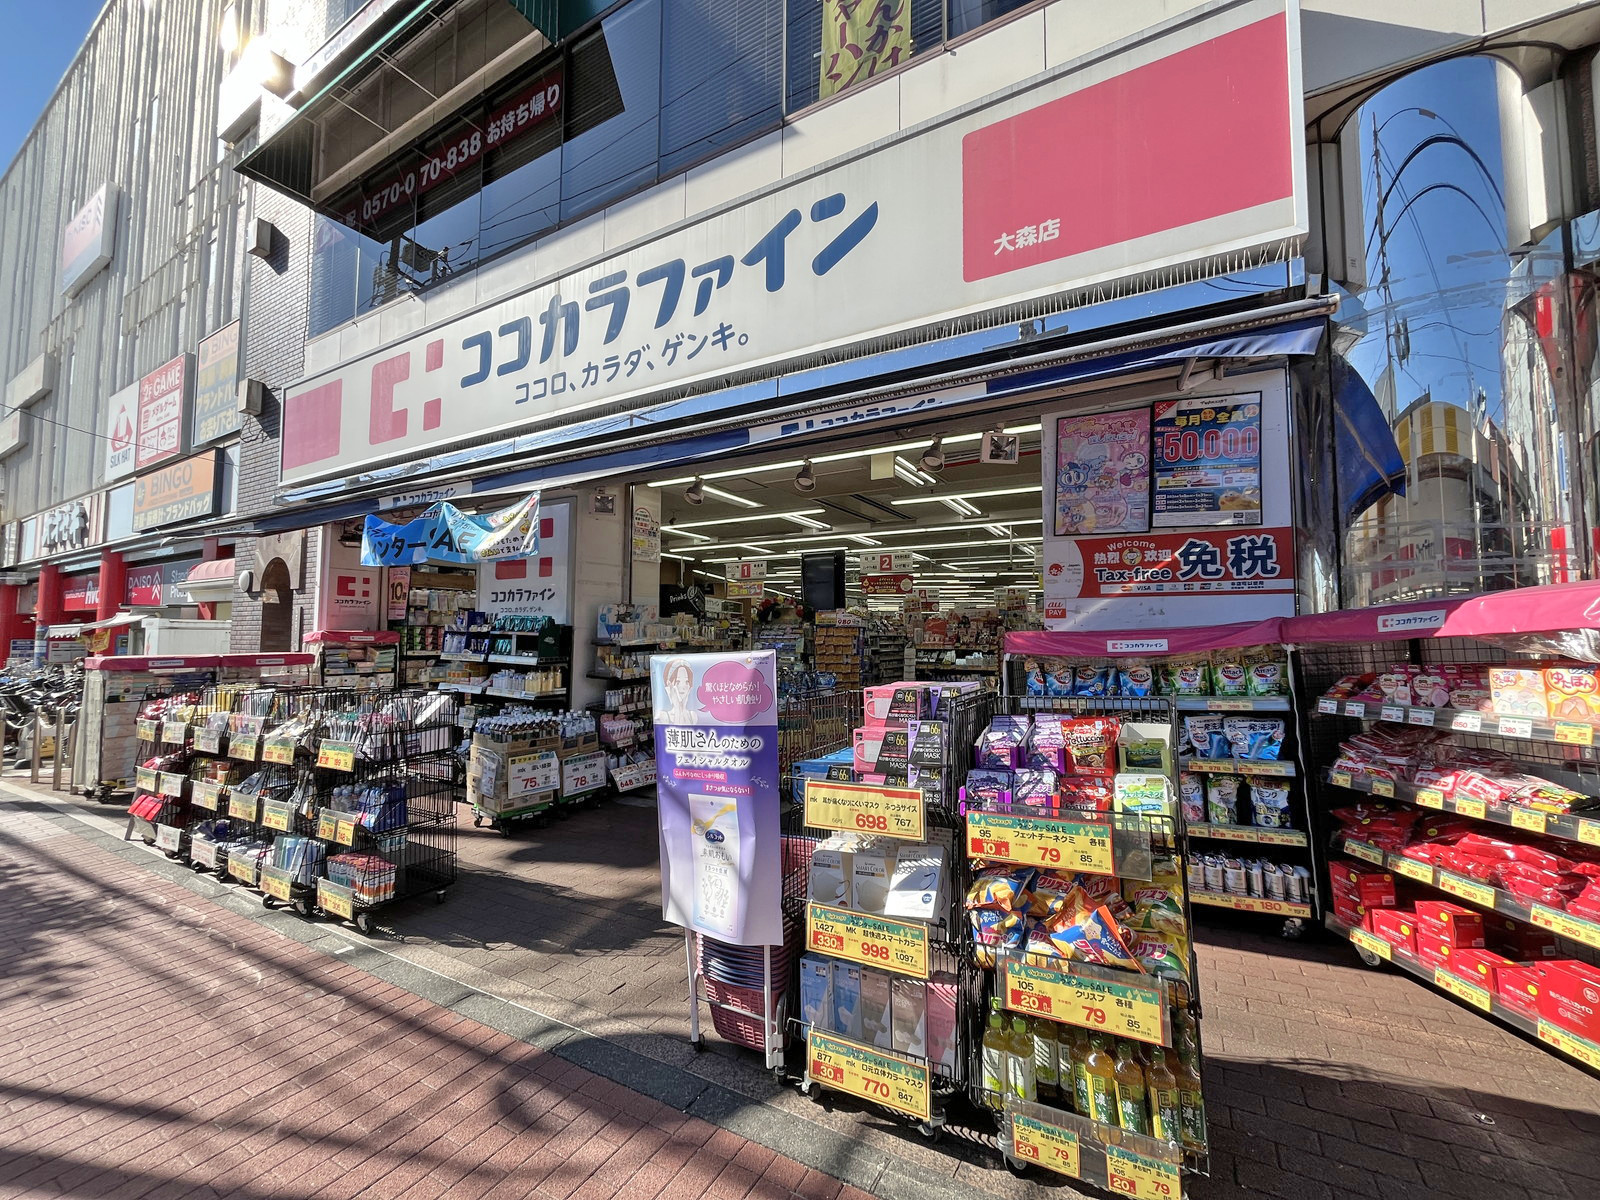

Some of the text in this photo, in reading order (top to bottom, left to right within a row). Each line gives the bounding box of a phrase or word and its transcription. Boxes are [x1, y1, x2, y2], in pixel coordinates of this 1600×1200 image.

[486, 83, 560, 144] お持ち帰り
[993, 217, 1060, 256] 大森店
[460, 191, 879, 389] ココカラファイン
[515, 320, 750, 405] ココロ、カラダ、ゲンキ。
[153, 364, 181, 397] GAME
[1175, 414, 1201, 427] 毎月
[1163, 426, 1260, 462] 50,000
[109, 451, 131, 469] SILK HAT
[151, 461, 193, 497] BINGO
[1107, 539, 1156, 551] Welcome
[881, 557, 890, 569] 2
[1177, 535, 1278, 581] 免税
[742, 565, 748, 576] 1
[1093, 566, 1172, 582] Tax-free
[129, 574, 152, 590] DAISO
[490, 587, 556, 603] ココカラファイン
[669, 592, 687, 603] Drinks
[1395, 614, 1440, 626] ココカラファイン
[1123, 641, 1164, 649] ココカラファイン
[1128, 670, 1150, 680] Attack
[1220, 667, 1244, 677] Attack
[1253, 665, 1278, 676] Attack
[712, 694, 762, 705] やさしい肌触り
[1453, 720, 1468, 728] 850
[666, 728, 762, 751] 薄肌さんのための
[676, 755, 750, 767] フェイシャルタオル
[521, 776, 537, 789] 75
[573, 776, 587, 788] 78
[620, 780, 634, 789] 648
[884, 802, 918, 813] ふつうサイズ
[855, 813, 912, 830] 698 767
[979, 829, 1107, 847] 95 フェットチーネグミ 各種
[982, 842, 1093, 863] 10 79 85
[1134, 888, 1169, 902] クリスプ
[1259, 901, 1282, 911] 180
[845, 926, 857, 934] MK
[862, 929, 922, 948] 超快適スマートカラー
[817, 935, 837, 948] 330
[861, 942, 890, 961] 998
[1017, 980, 1134, 1010] 105 クリスプ 各種
[1020, 995, 1141, 1029] 20 79 85
[1571, 1046, 1591, 1062] 703
[816, 1052, 833, 1063] 877
[861, 1063, 924, 1089] 口元立体カラーマスク
[820, 1066, 914, 1103] 30 770 847
[1018, 1134, 1030, 1143] 105
[1018, 1144, 1034, 1157] 20
[1052, 1146, 1069, 1161] 79
[1113, 1167, 1126, 1177] 105
[1112, 1177, 1170, 1195] 20 79
